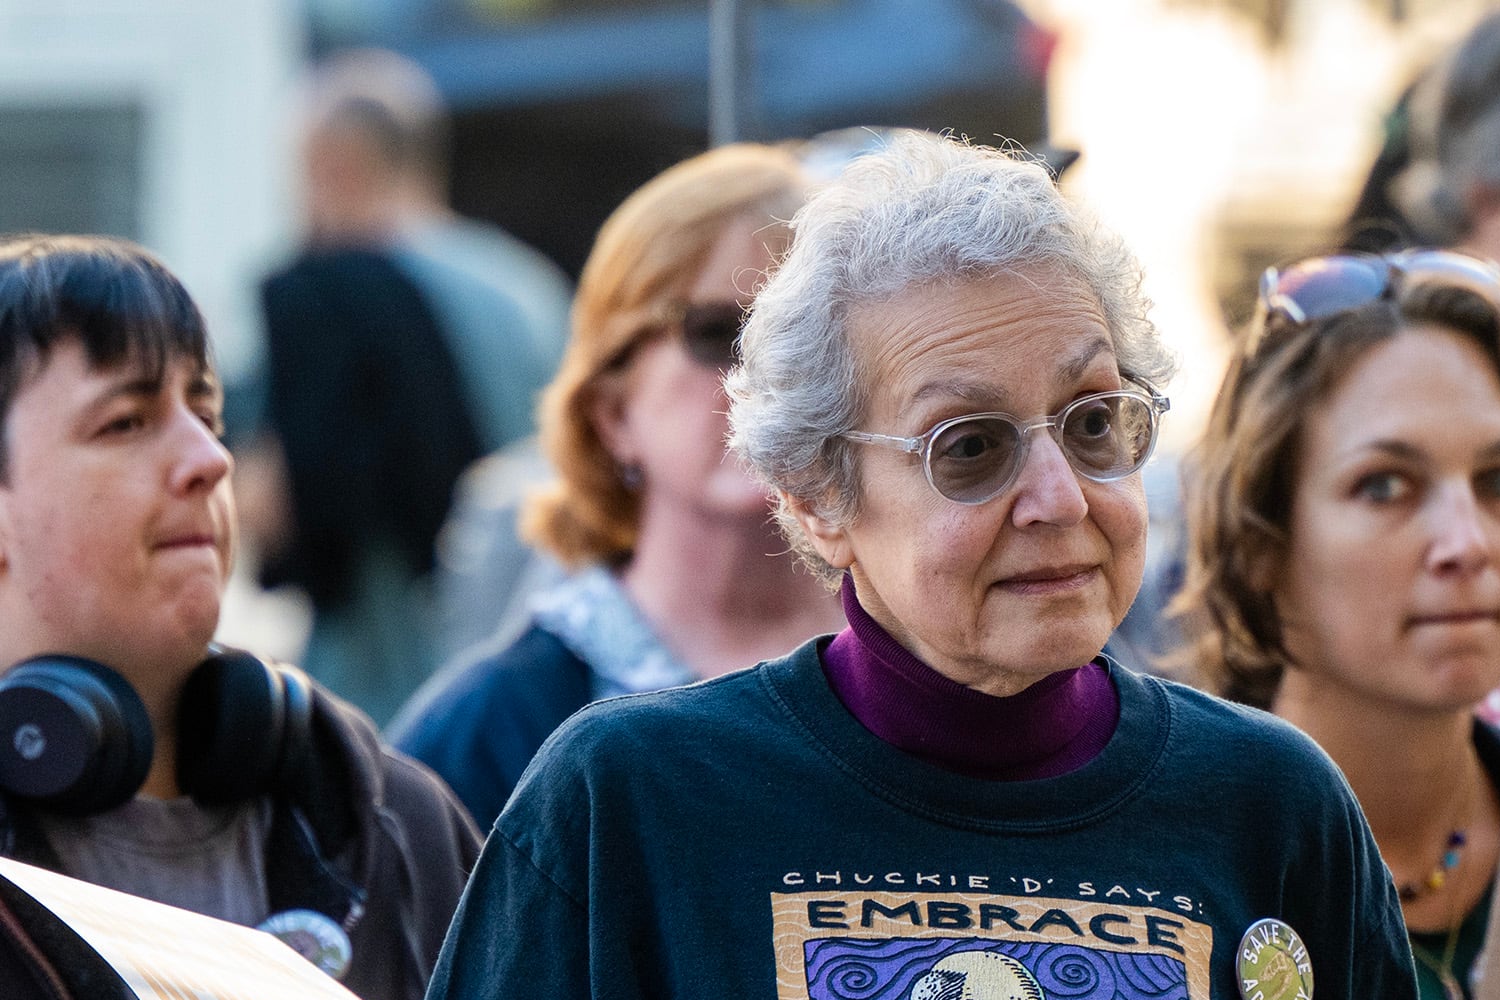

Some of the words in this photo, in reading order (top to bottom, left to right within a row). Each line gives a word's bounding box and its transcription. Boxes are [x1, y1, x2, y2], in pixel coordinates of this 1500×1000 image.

[783, 870, 990, 889] CHUCKIE
[1078, 881, 1203, 915] SAYS:
[807, 898, 1187, 956] EMBRACE
[1243, 923, 1281, 965] SAVE
[1286, 932, 1311, 976] THE
